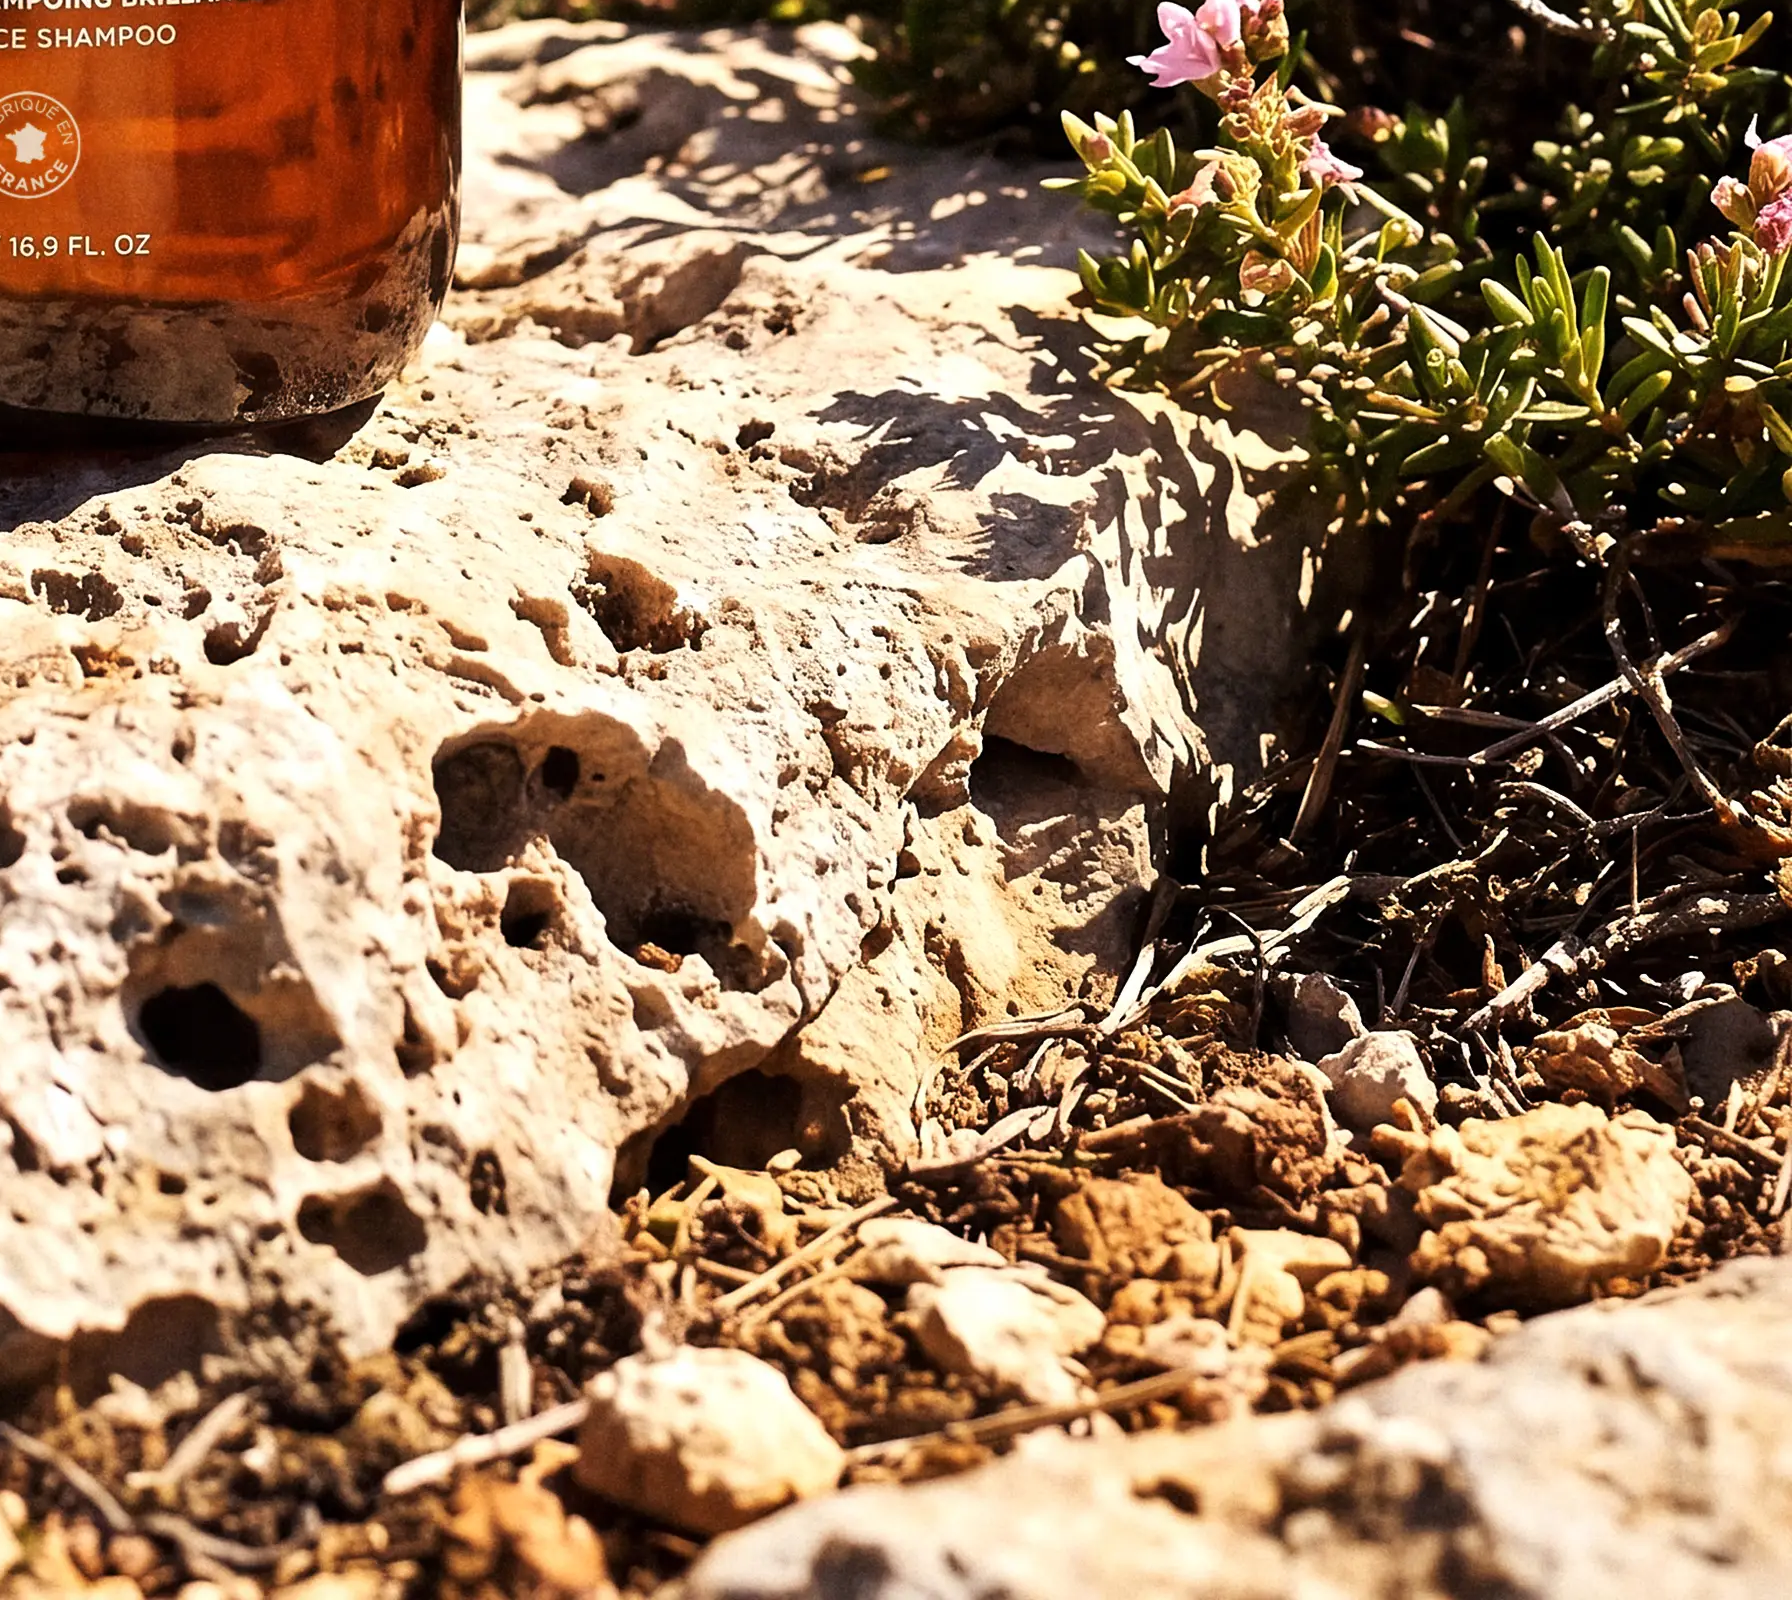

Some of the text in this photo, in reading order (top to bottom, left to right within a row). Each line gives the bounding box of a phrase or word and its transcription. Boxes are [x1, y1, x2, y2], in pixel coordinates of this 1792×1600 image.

[37, 23, 176, 49] SHAMPOO
[56, 120, 75, 145] EN
[9, 235, 58, 259] 16,9
[68, 235, 106, 256] FL.
[114, 234, 151, 255] OZ
